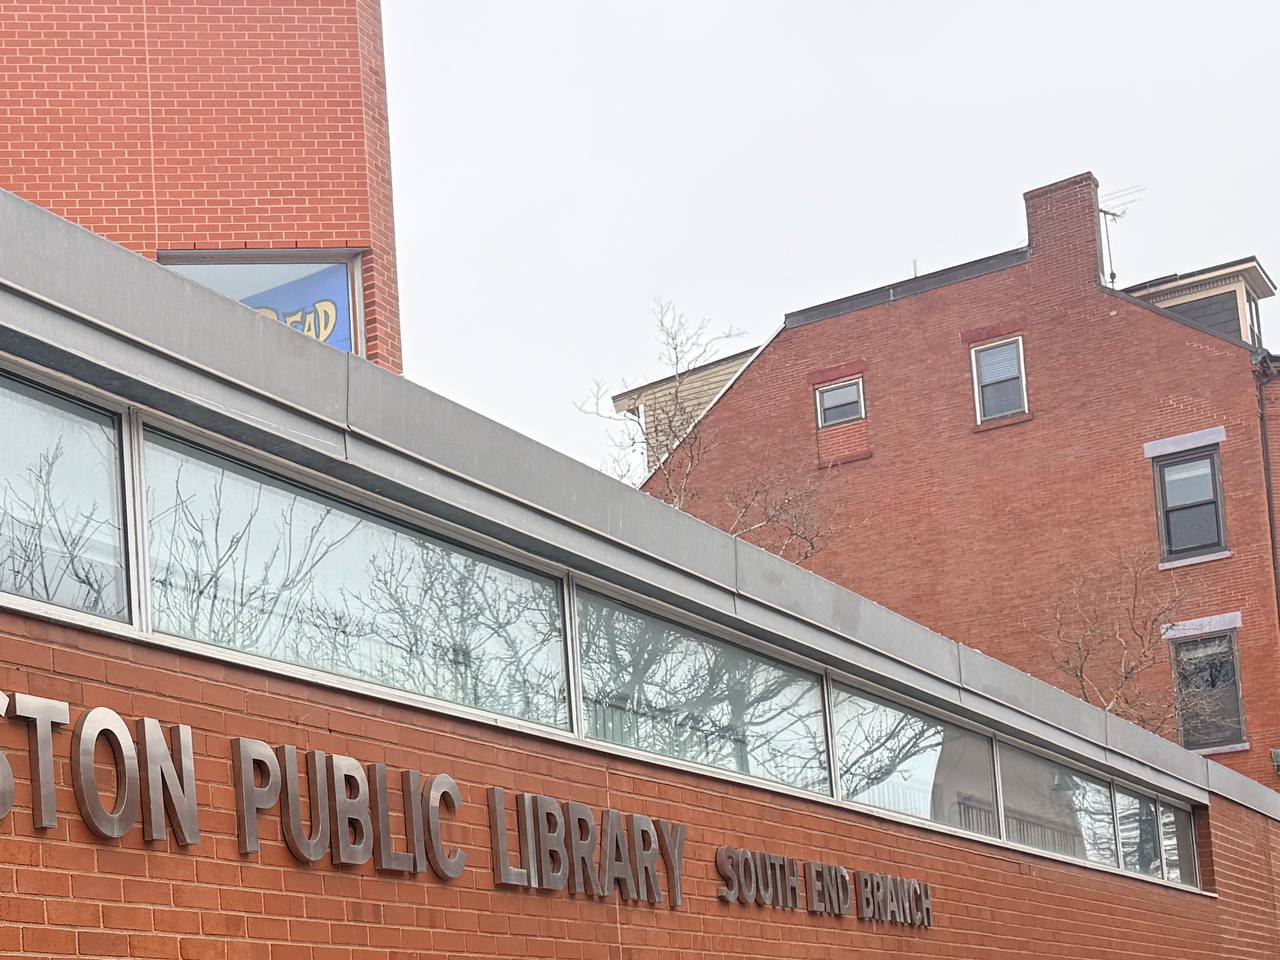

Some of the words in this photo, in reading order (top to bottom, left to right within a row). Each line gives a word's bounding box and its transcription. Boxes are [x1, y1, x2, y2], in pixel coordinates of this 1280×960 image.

[231, 736, 468, 881] PUBLIC
[487, 786, 687, 909] LIBRARY
[715, 846, 801, 910] SOUTH
[804, 860, 852, 916] END
[854, 870, 934, 929] BRANCH
